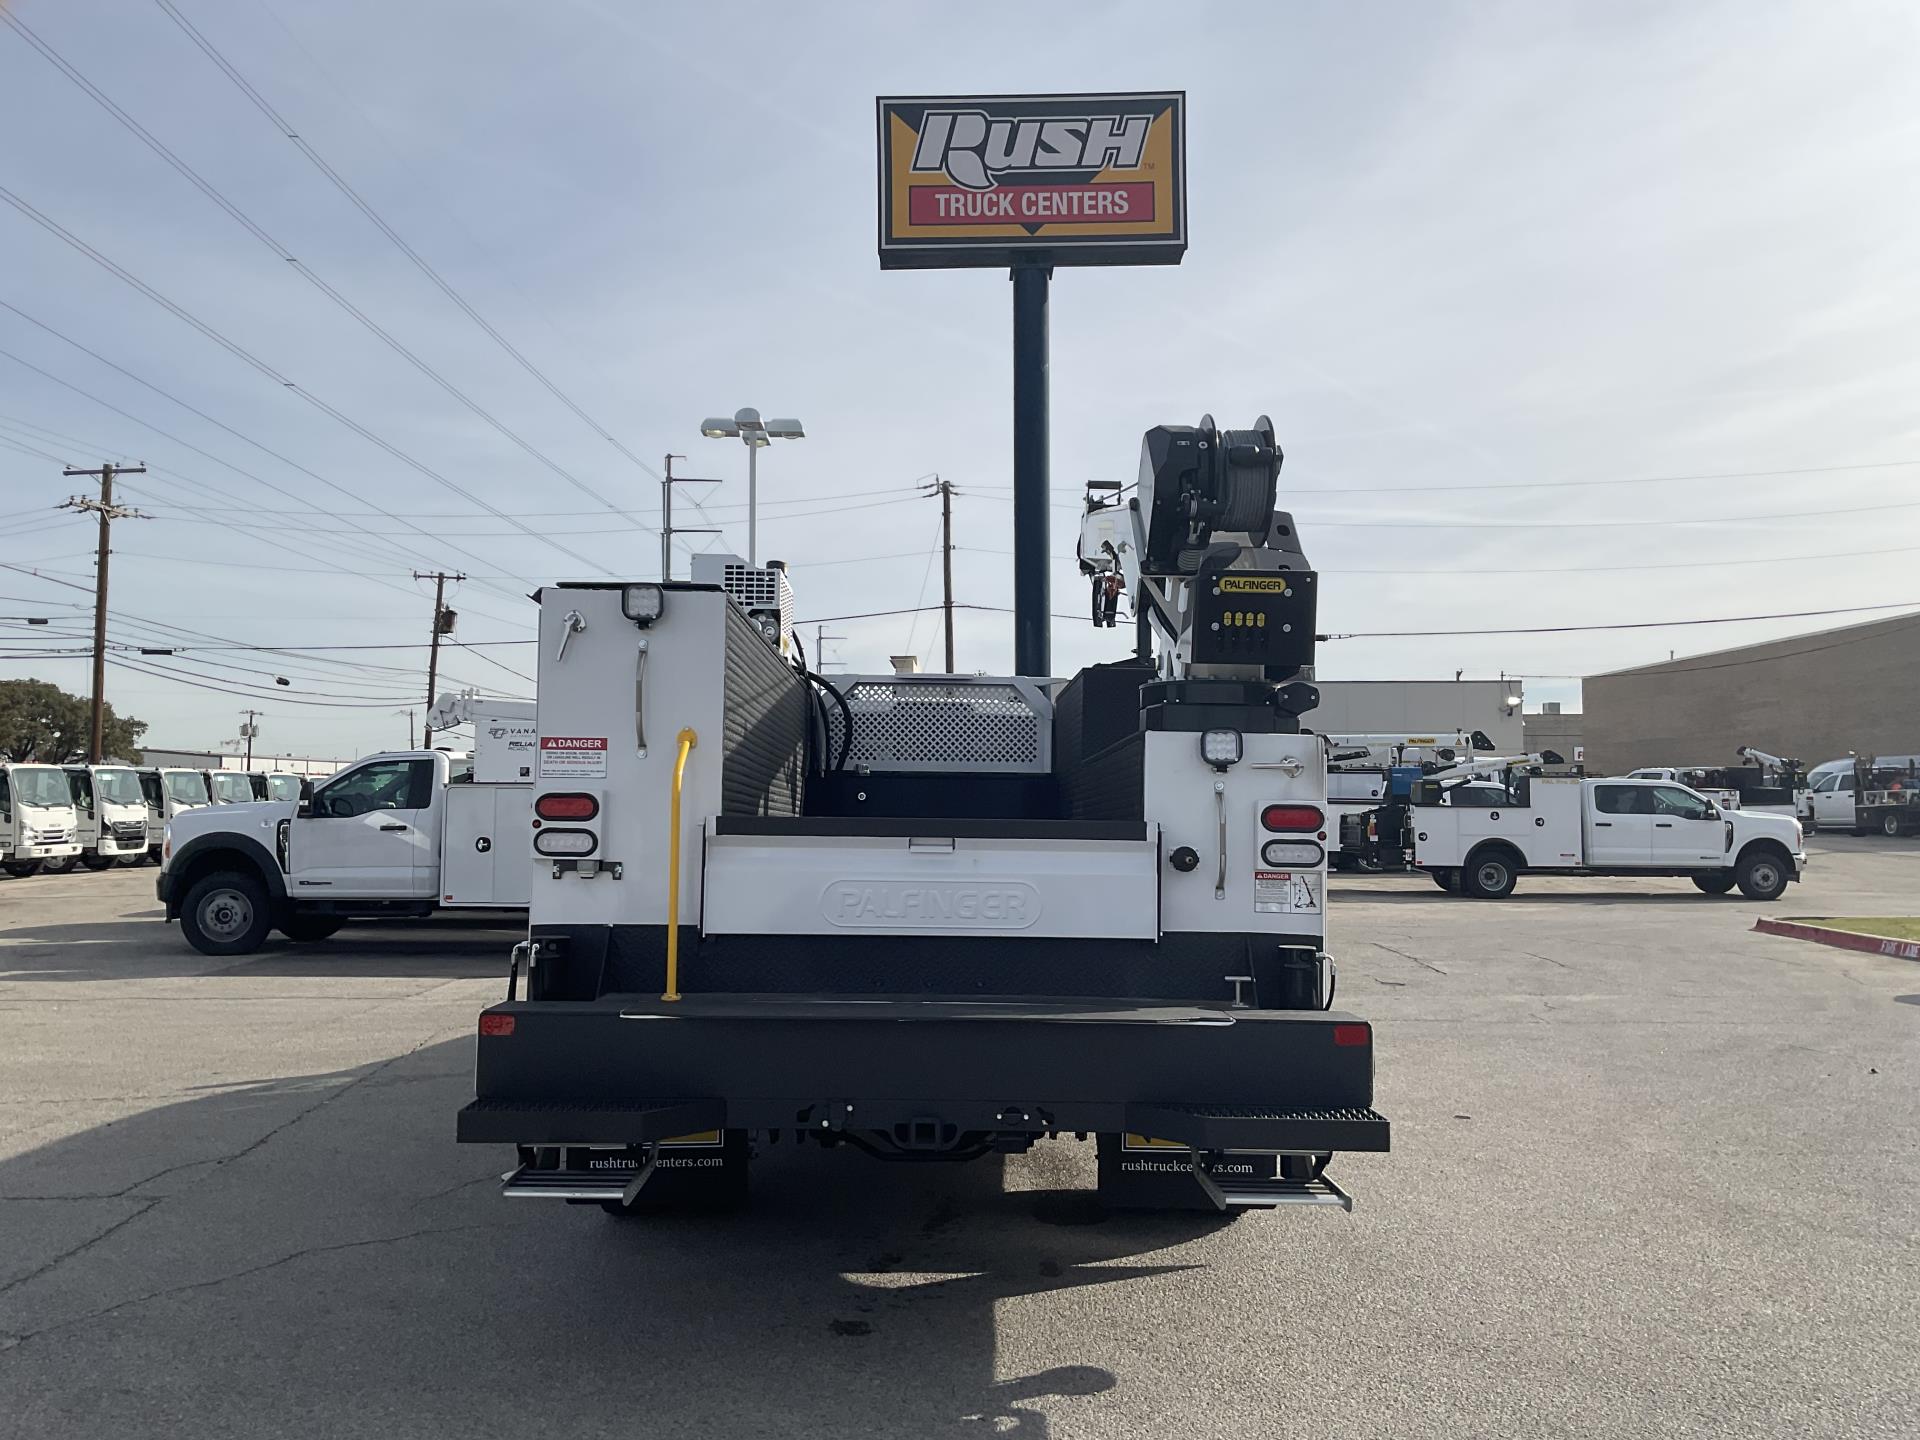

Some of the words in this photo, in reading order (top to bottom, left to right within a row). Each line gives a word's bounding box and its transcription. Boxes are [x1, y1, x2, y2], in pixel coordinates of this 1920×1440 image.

[935, 193, 1015, 217] TRUCK
[1021, 190, 1129, 215] CENTERS
[1224, 579, 1281, 590] PALFINGER
[558, 739, 602, 748] DANGER
[837, 888, 1027, 920] PALFINGER
